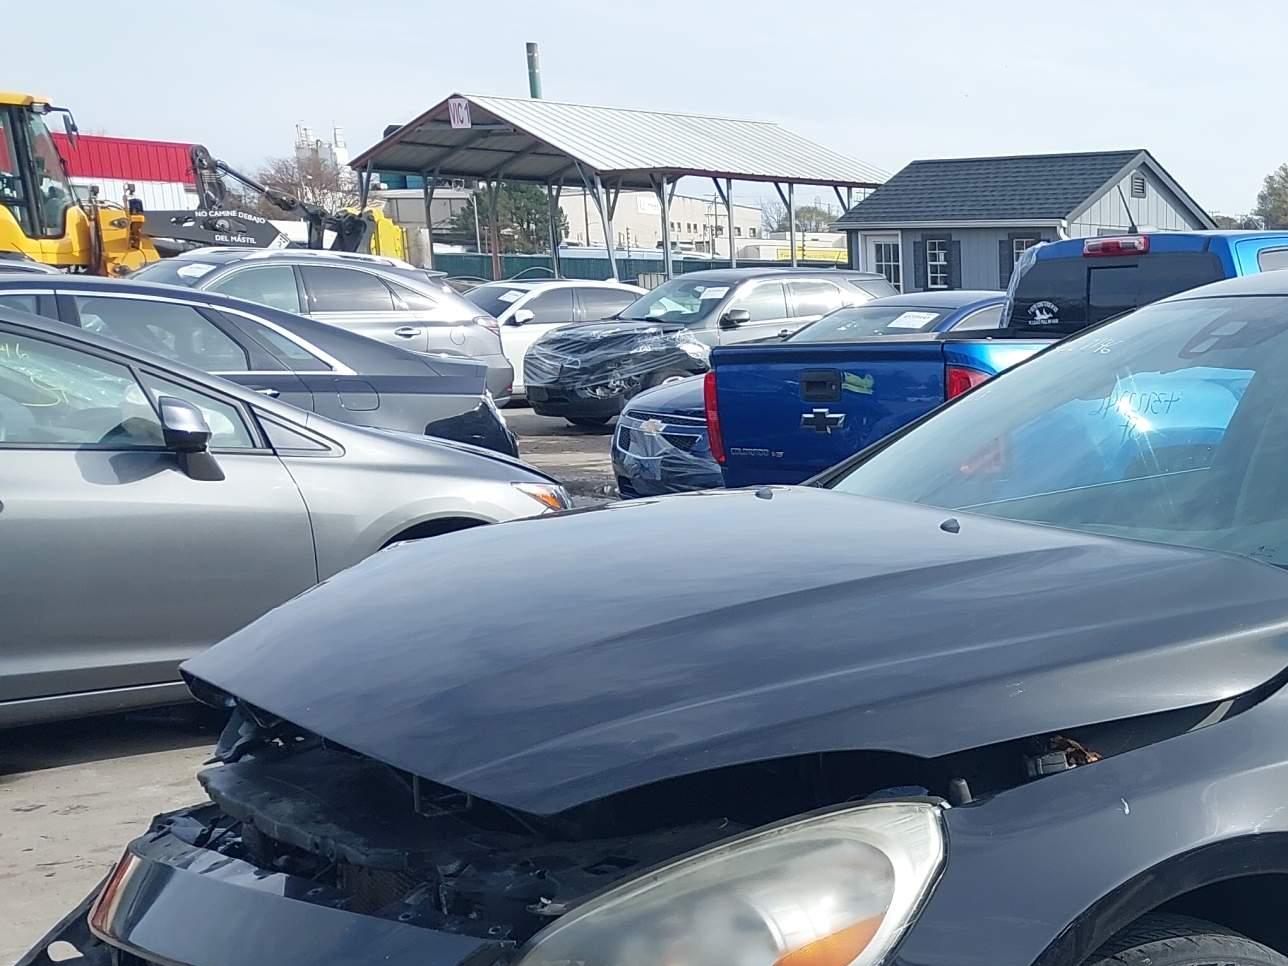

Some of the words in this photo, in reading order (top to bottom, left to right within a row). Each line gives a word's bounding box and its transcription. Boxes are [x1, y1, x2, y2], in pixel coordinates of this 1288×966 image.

[450, 102, 464, 125] VIC
[238, 212, 266, 224] DEBAJO
[214, 234, 229, 242] DEL
[230, 234, 256, 244] MÁSTIL
